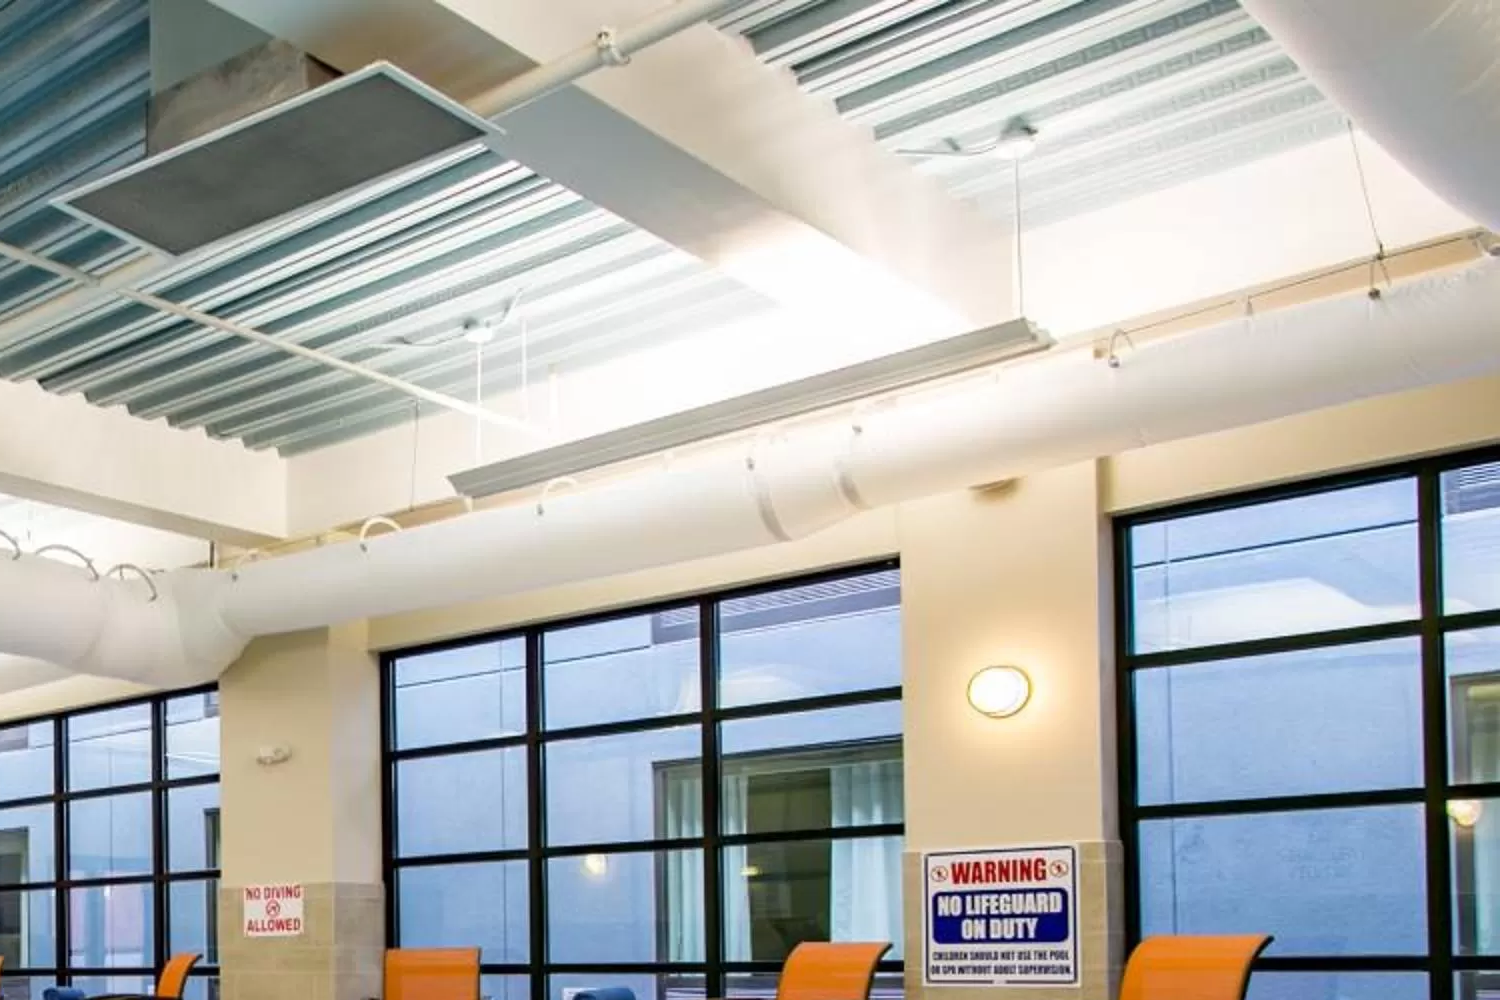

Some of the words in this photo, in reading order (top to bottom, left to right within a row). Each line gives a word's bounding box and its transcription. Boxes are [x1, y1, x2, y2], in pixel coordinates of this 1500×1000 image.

[951, 858, 1047, 884] WARNING
[245, 887, 261, 900] NO
[263, 885, 301, 899] DIVING
[937, 895, 962, 917] NO
[965, 892, 1062, 916] LIFEGUARD
[247, 918, 301, 932] ALLOWED
[961, 919, 987, 940] ON
[989, 918, 1039, 939] DUTY
[932, 951, 969, 960] CHILDREN
[970, 951, 999, 960] SHOULD
[1001, 951, 1016, 960] NOT
[1033, 950, 1048, 960] THE
[1050, 950, 1069, 960] POOL
[931, 965, 941, 974] OR
[958, 965, 992, 974] WITHOUT
[994, 965, 1017, 974] ADULT
